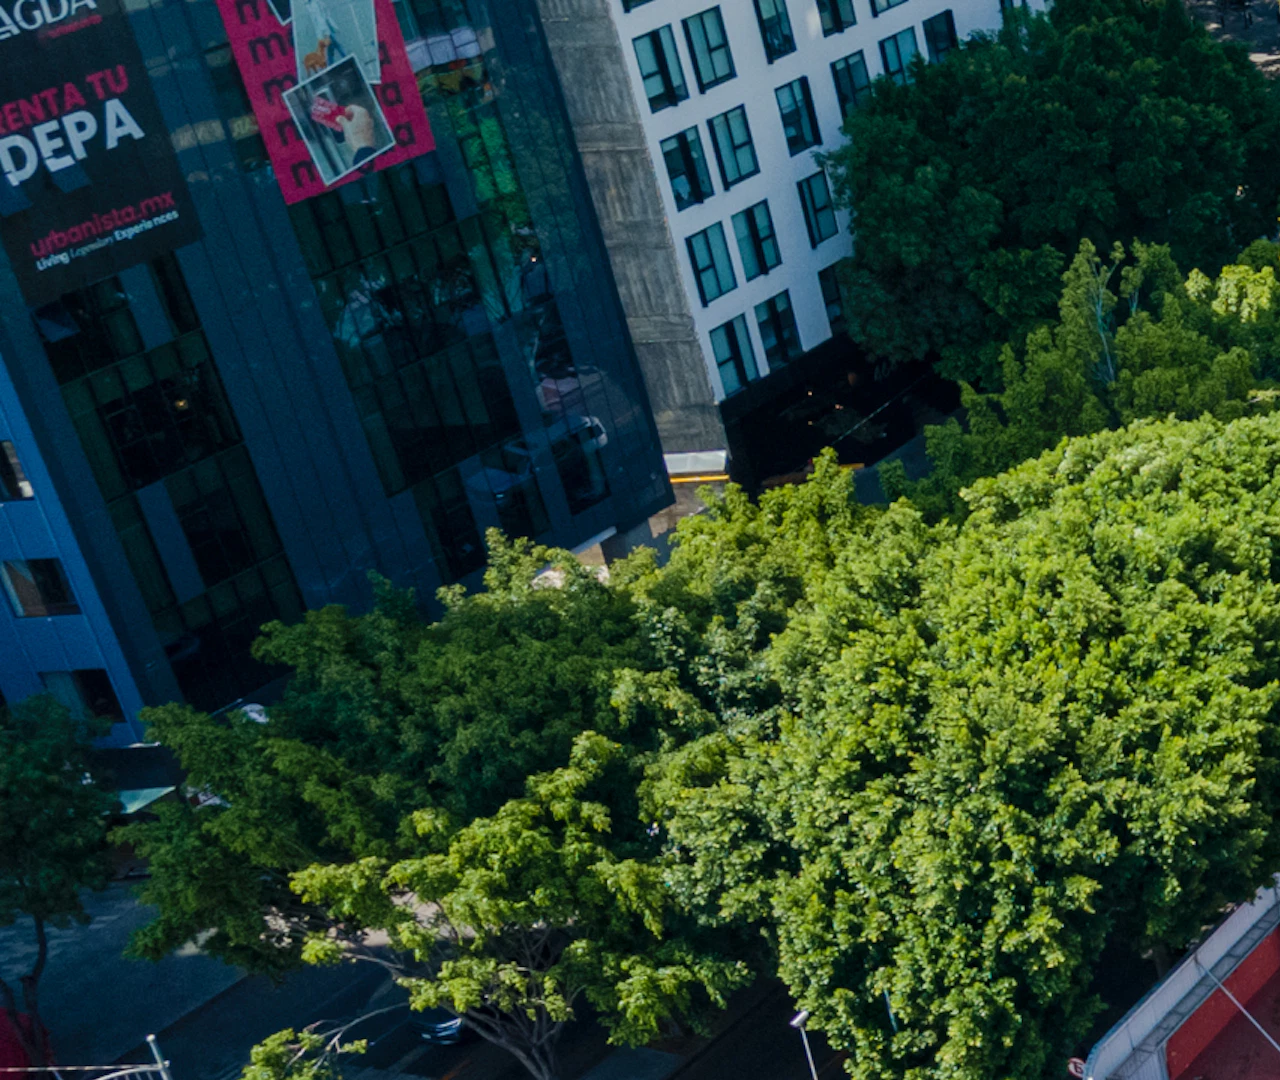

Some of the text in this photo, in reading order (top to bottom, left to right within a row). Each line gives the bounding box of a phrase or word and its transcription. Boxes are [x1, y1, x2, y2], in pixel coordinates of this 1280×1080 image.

[0, 64, 129, 134] ENTA TU
[0, 98, 145, 187] DEPA
[30, 191, 176, 257] urbanista.mx
[36, 210, 180, 271] Living Experiences
